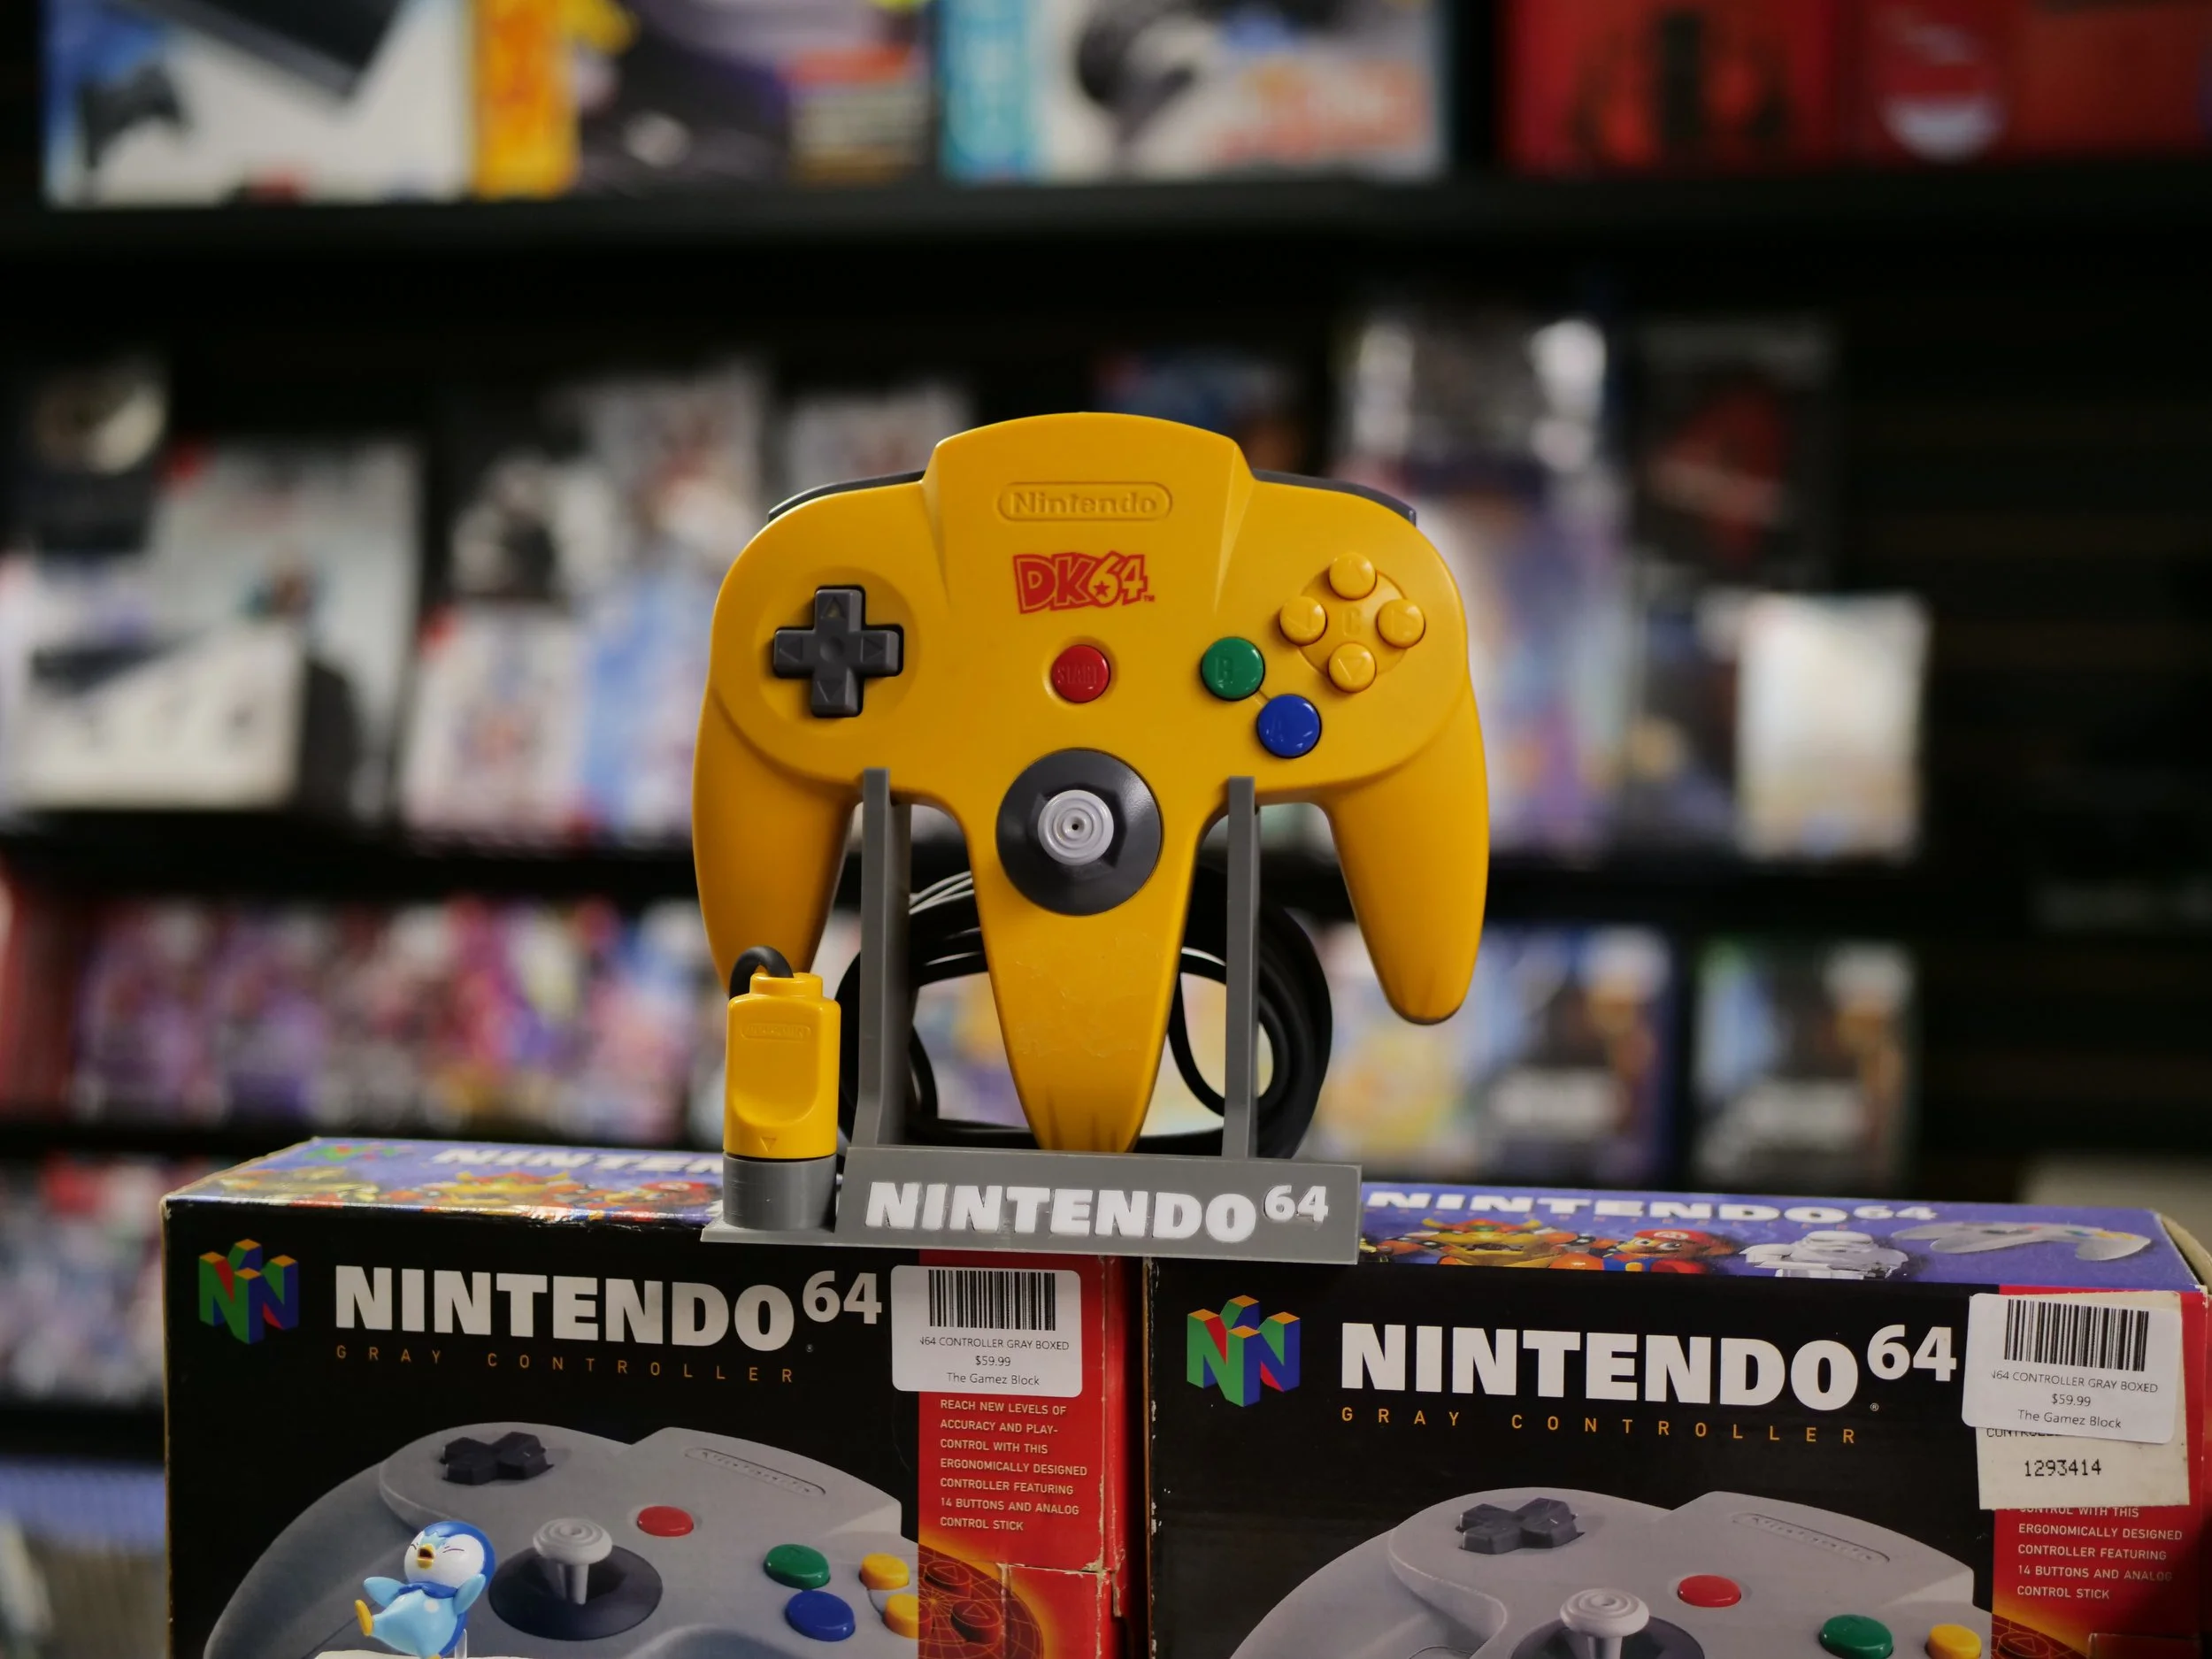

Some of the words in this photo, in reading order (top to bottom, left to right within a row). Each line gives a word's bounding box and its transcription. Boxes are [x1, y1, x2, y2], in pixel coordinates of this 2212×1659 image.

[1010, 492, 1157, 514] Nintendo
[864, 1181, 1257, 1242] NINTENDO
[1263, 1185, 1328, 1223] 64
[1366, 1191, 1848, 1224] NINTENDO
[1853, 1204, 1939, 1221] 64
[335, 1264, 795, 1352] NINTENDO
[802, 1270, 882, 1325] 64
[939, 1337, 1004, 1348] CONTROLLER
[1007, 1339, 1033, 1349] GRAY
[1035, 1340, 1070, 1351] BOXED
[336, 1344, 442, 1364] GRAY
[487, 1352, 793, 1383] CONTROLLER
[975, 1356, 1011, 1367] $59.99
[1341, 1322, 1859, 1411] NINTENDO
[1867, 1325, 1957, 1382] 64
[947, 1372, 966, 1384] The
[970, 1373, 1008, 1386] Gamez
[1011, 1375, 1040, 1386] Block
[2012, 1371, 2085, 1386] CONTROLLER
[2088, 1378, 2117, 1390] GRAY
[2121, 1381, 2158, 1394] BOXED
[941, 1399, 976, 1411] REACH
[979, 1402, 1004, 1412] NEW
[1009, 1402, 1048, 1415] LEVELS
[1052, 1405, 1067, 1416] OF
[2051, 1393, 2091, 1407] $59.99
[941, 1418, 995, 1432] ACCURACY
[999, 1423, 1023, 1433] AND
[1026, 1424, 1059, 1435] PLAY-
[1341, 1406, 1460, 1427] GRAY
[1510, 1415, 1855, 1444] CONTROLLER
[2018, 1409, 2039, 1422] The
[2044, 1411, 2085, 1425] Gamez
[2089, 1416, 2122, 1428] Block
[941, 1438, 989, 1451] CONTROL
[993, 1441, 1020, 1453] WITH
[1024, 1443, 1048, 1454] THIS
[941, 1457, 1030, 1472] ERGONOMICALLY
[1033, 1463, 1088, 1477] DESIGNED
[2024, 1458, 2102, 1478] 1293414
[941, 1478, 1010, 1491] CONTROLLER
[1014, 1481, 1074, 1495] FEATURING
[941, 1497, 952, 1508] 14
[956, 1499, 1005, 1511] BUTTONS
[1008, 1502, 1032, 1512] AND
[1035, 1503, 1079, 1516] ANALOG
[2112, 1507, 2139, 1518] THIS
[941, 1517, 989, 1530] CONTROL
[993, 1520, 1024, 1532] STICK
[2018, 1523, 2118, 1538] ERGONOMICALLY
[2123, 1528, 2183, 1540] DESIGNED
[2017, 1544, 2095, 1557] CONTROLLER
[2101, 1548, 2167, 1561] FEATURING
[2018, 1564, 2031, 1575] 14
[2035, 1565, 2089, 1578] BUTTONS
[2093, 1569, 2119, 1579] AND
[2124, 1570, 2173, 1583] ANALOG
[2017, 1585, 2071, 1599] CONTROL
[2076, 1588, 2110, 1600] STICK
